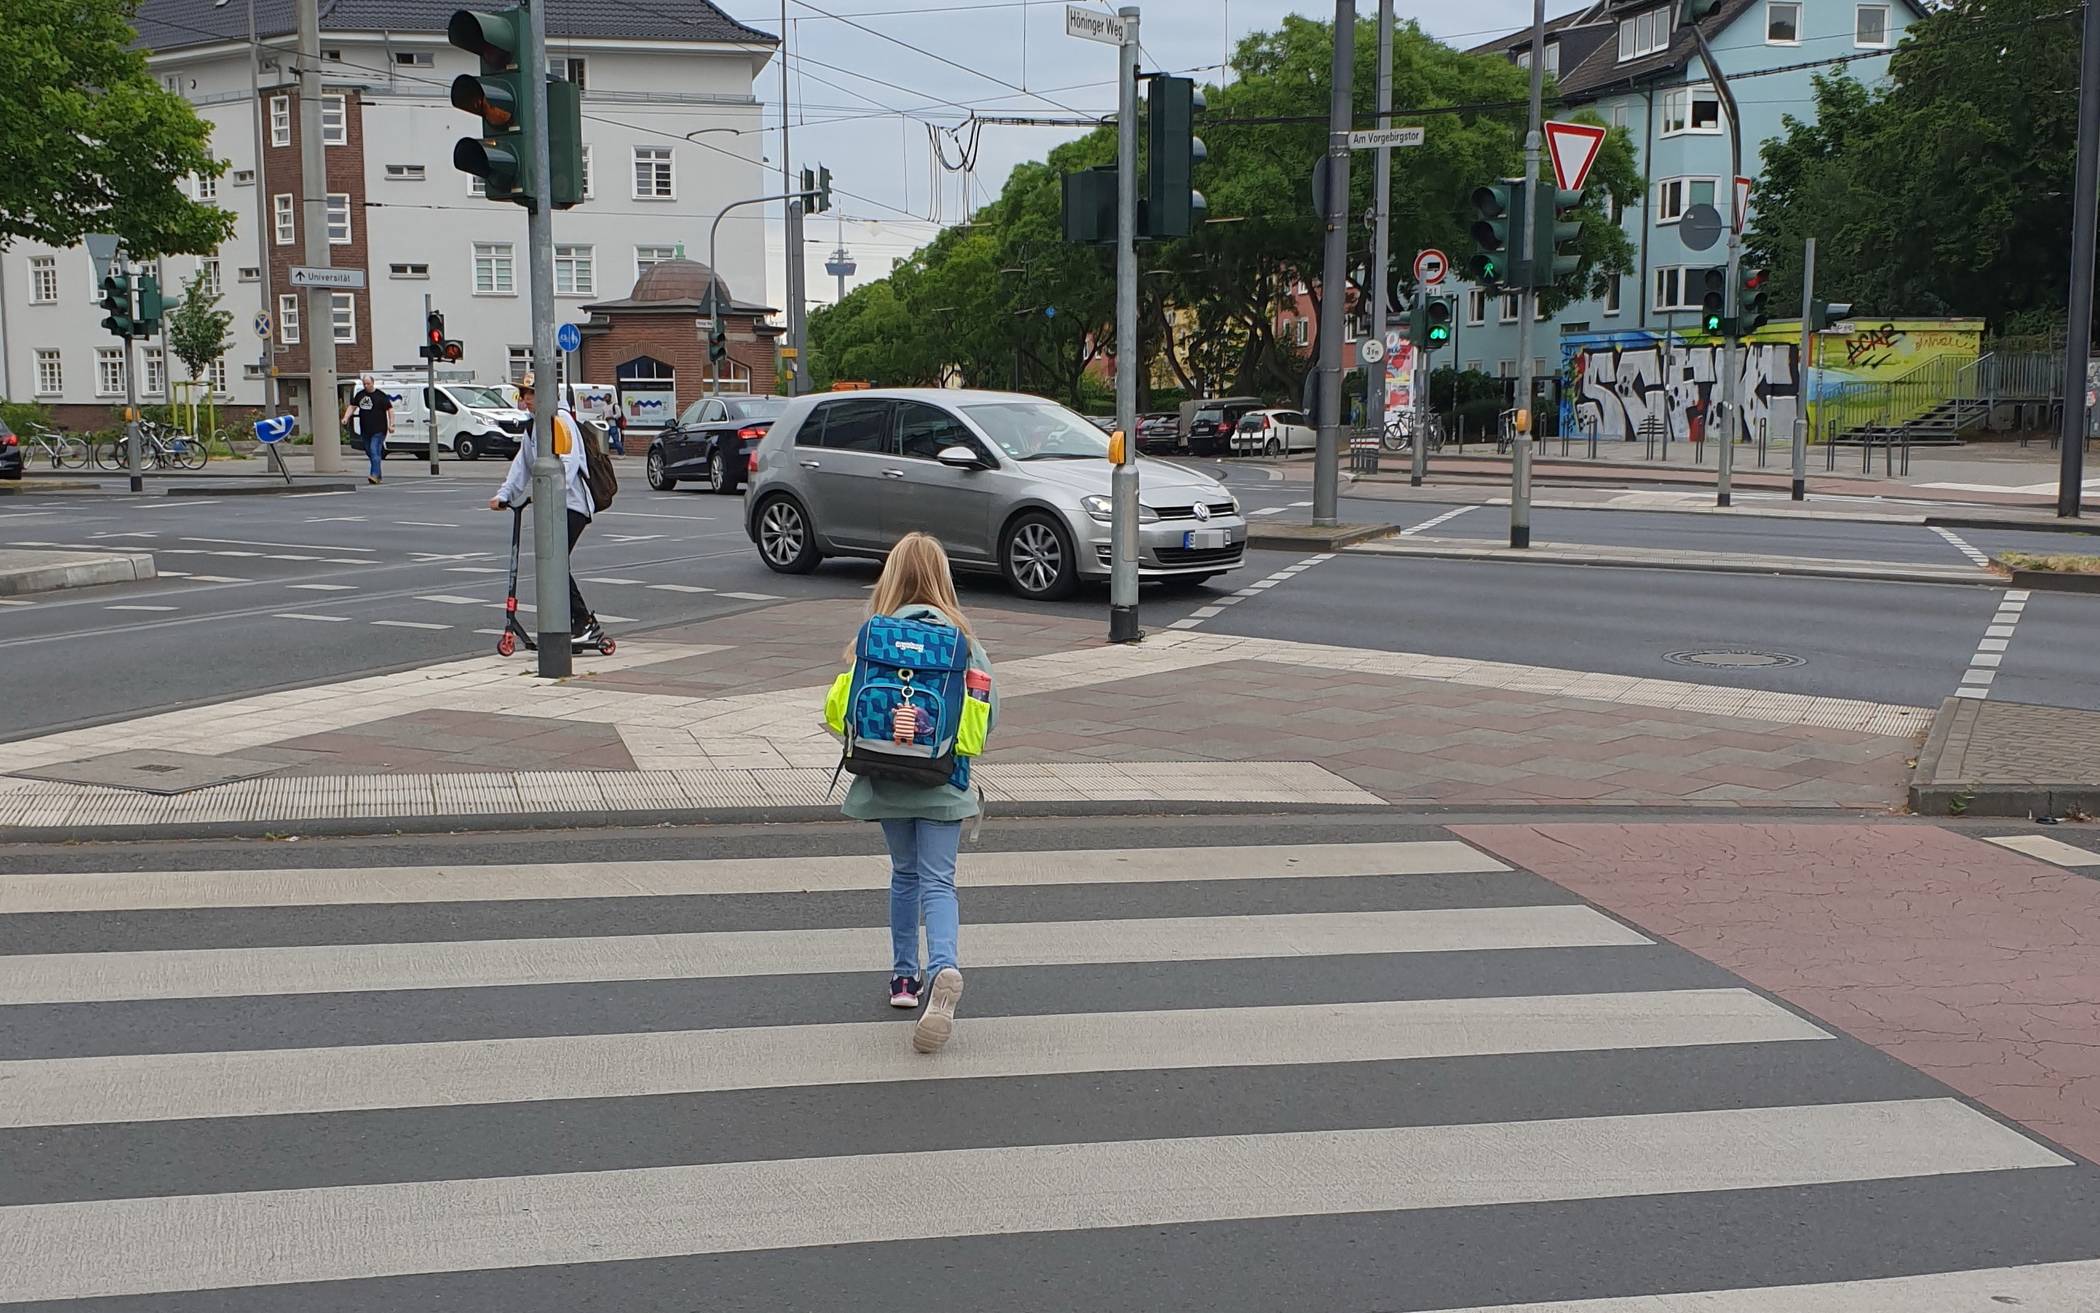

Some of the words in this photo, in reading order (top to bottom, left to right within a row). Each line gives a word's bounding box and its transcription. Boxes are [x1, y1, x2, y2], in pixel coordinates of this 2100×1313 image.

[1070, 10, 1104, 35] Höninger
[1106, 18, 1123, 41] Weg
[1353, 134, 1366, 144] Am
[1368, 131, 1419, 144] Vorgebirgstor
[308, 272, 350, 282] Universität
